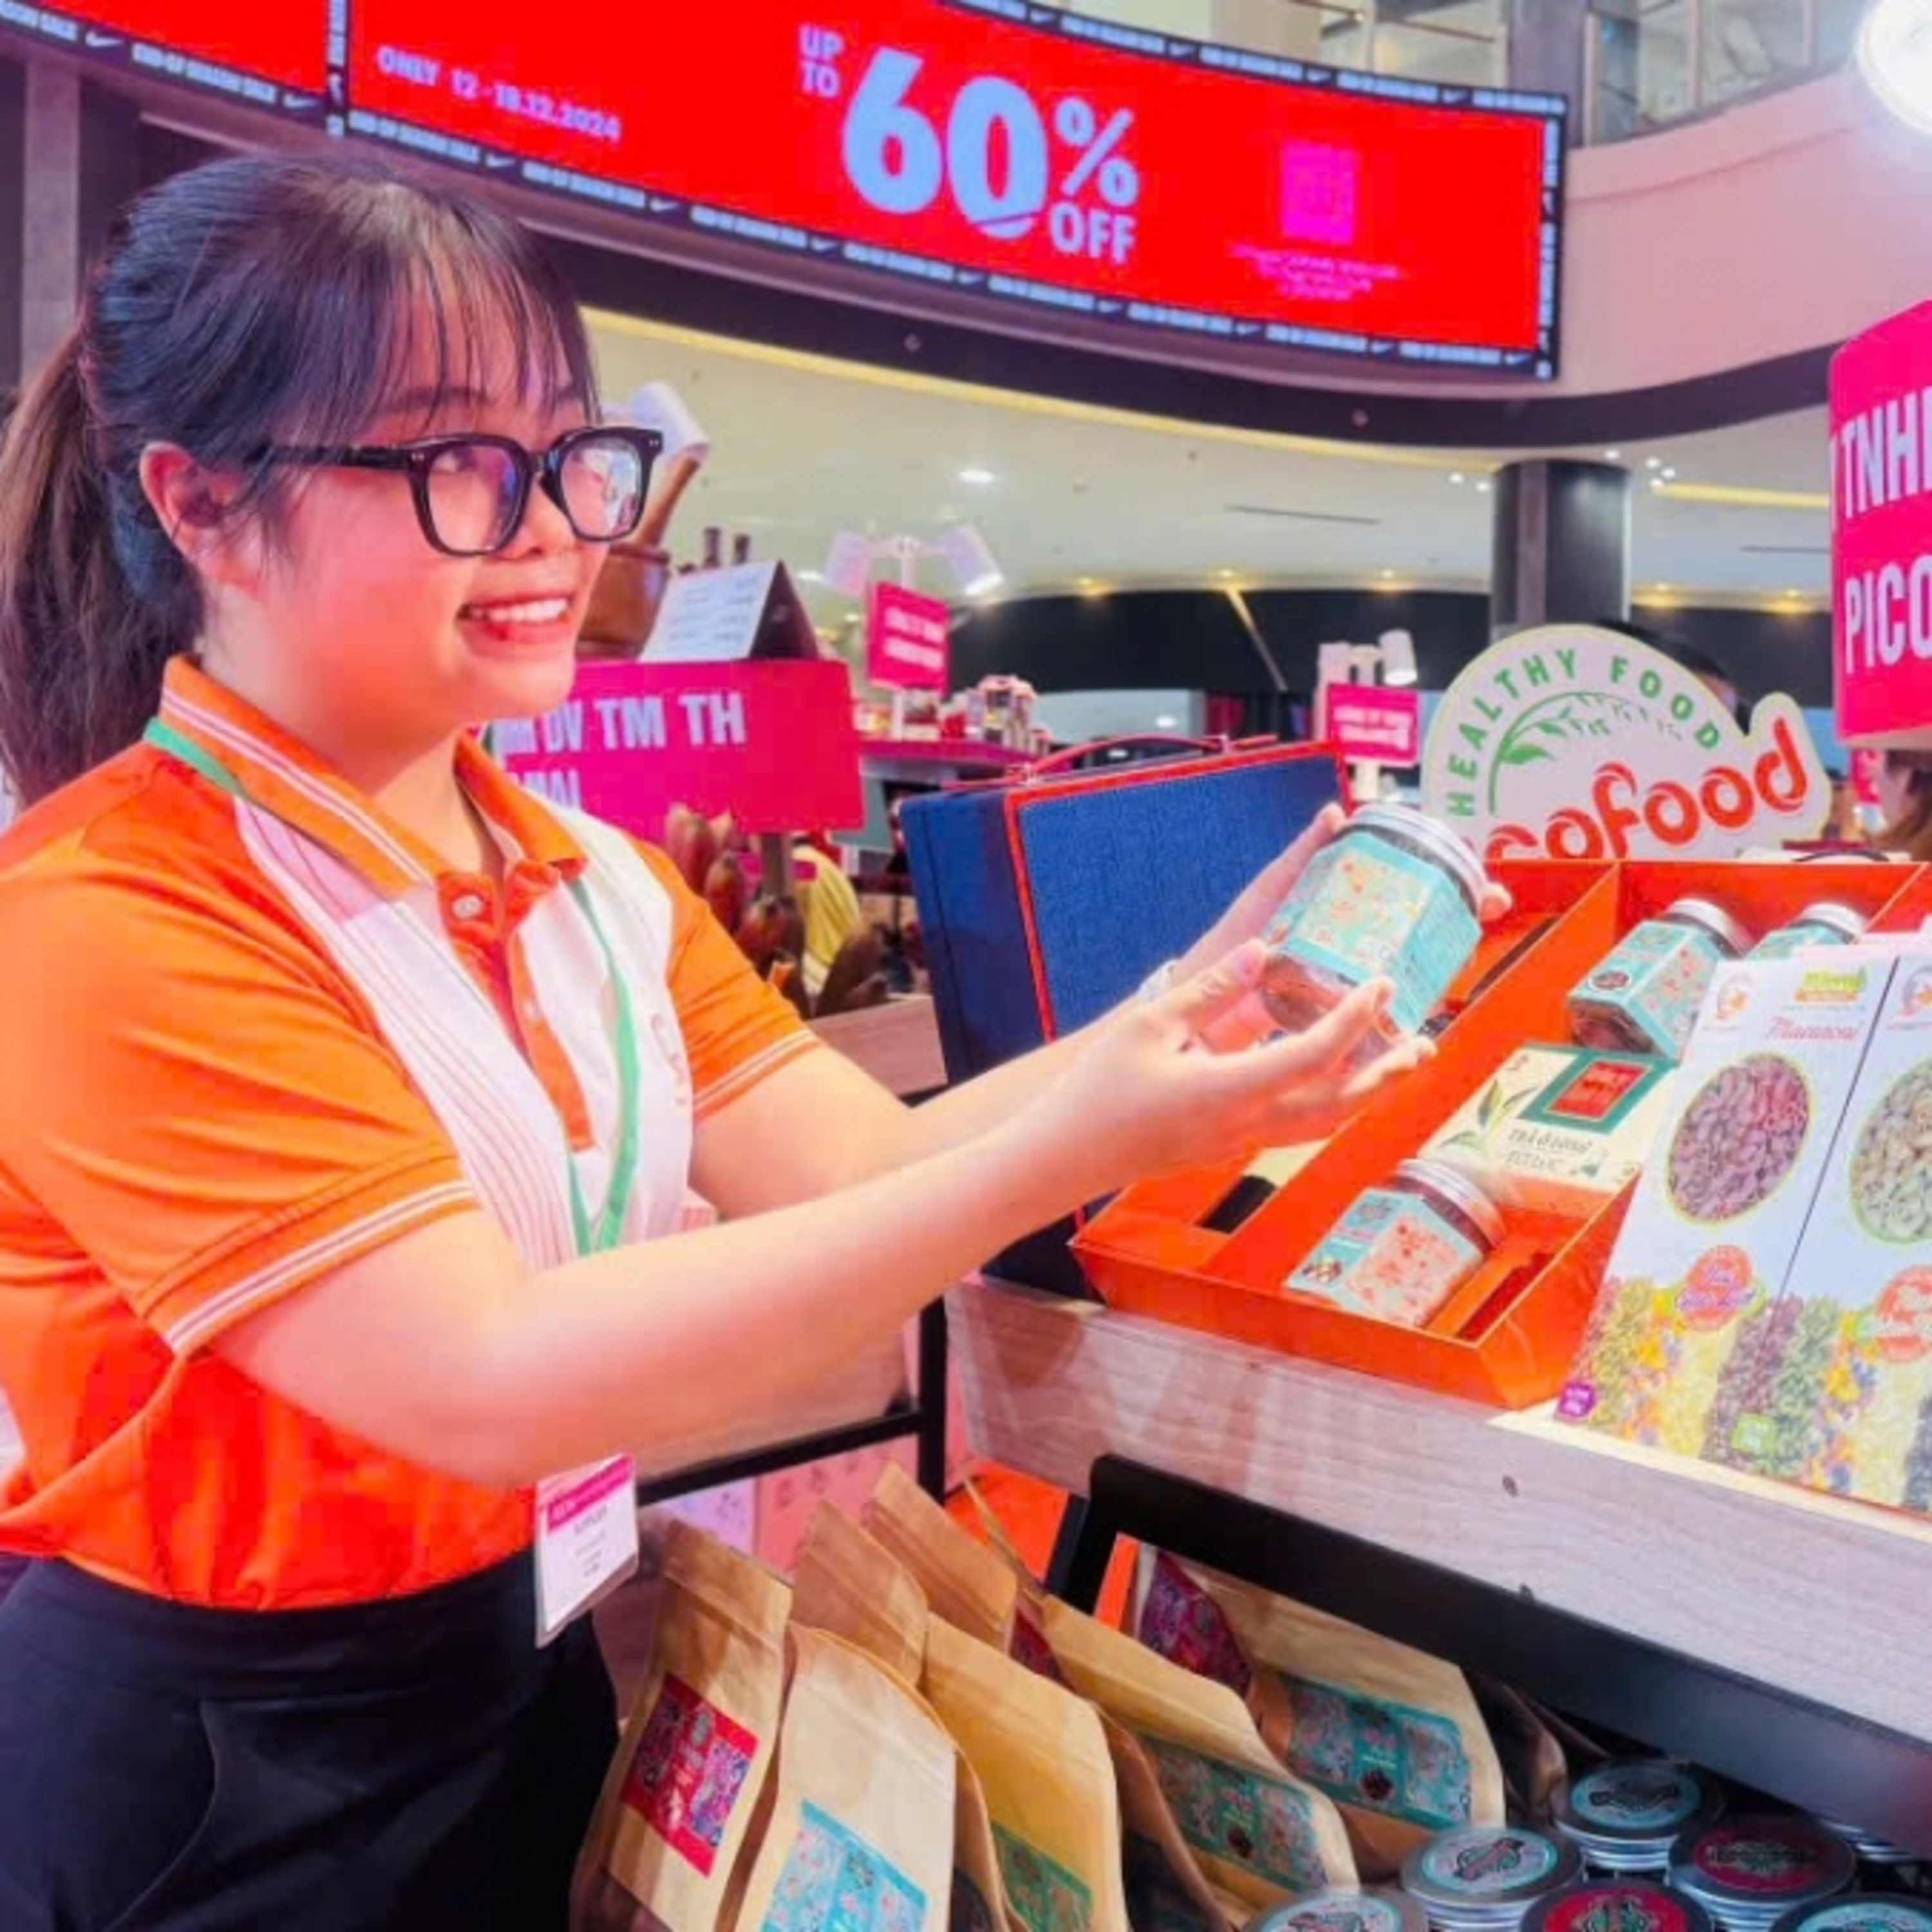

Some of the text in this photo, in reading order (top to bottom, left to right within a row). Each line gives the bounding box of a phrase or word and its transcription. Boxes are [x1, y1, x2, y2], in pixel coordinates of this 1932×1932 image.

[376, 45, 442, 86] ONLY
[799, 24, 843, 58] UP
[801, 62, 838, 98] TO
[1050, 201, 1136, 265] OFF
[594, 696, 667, 751] TM
[677, 691, 748, 747] TH
[1444, 647, 1721, 817] HEALTHY FOOD
